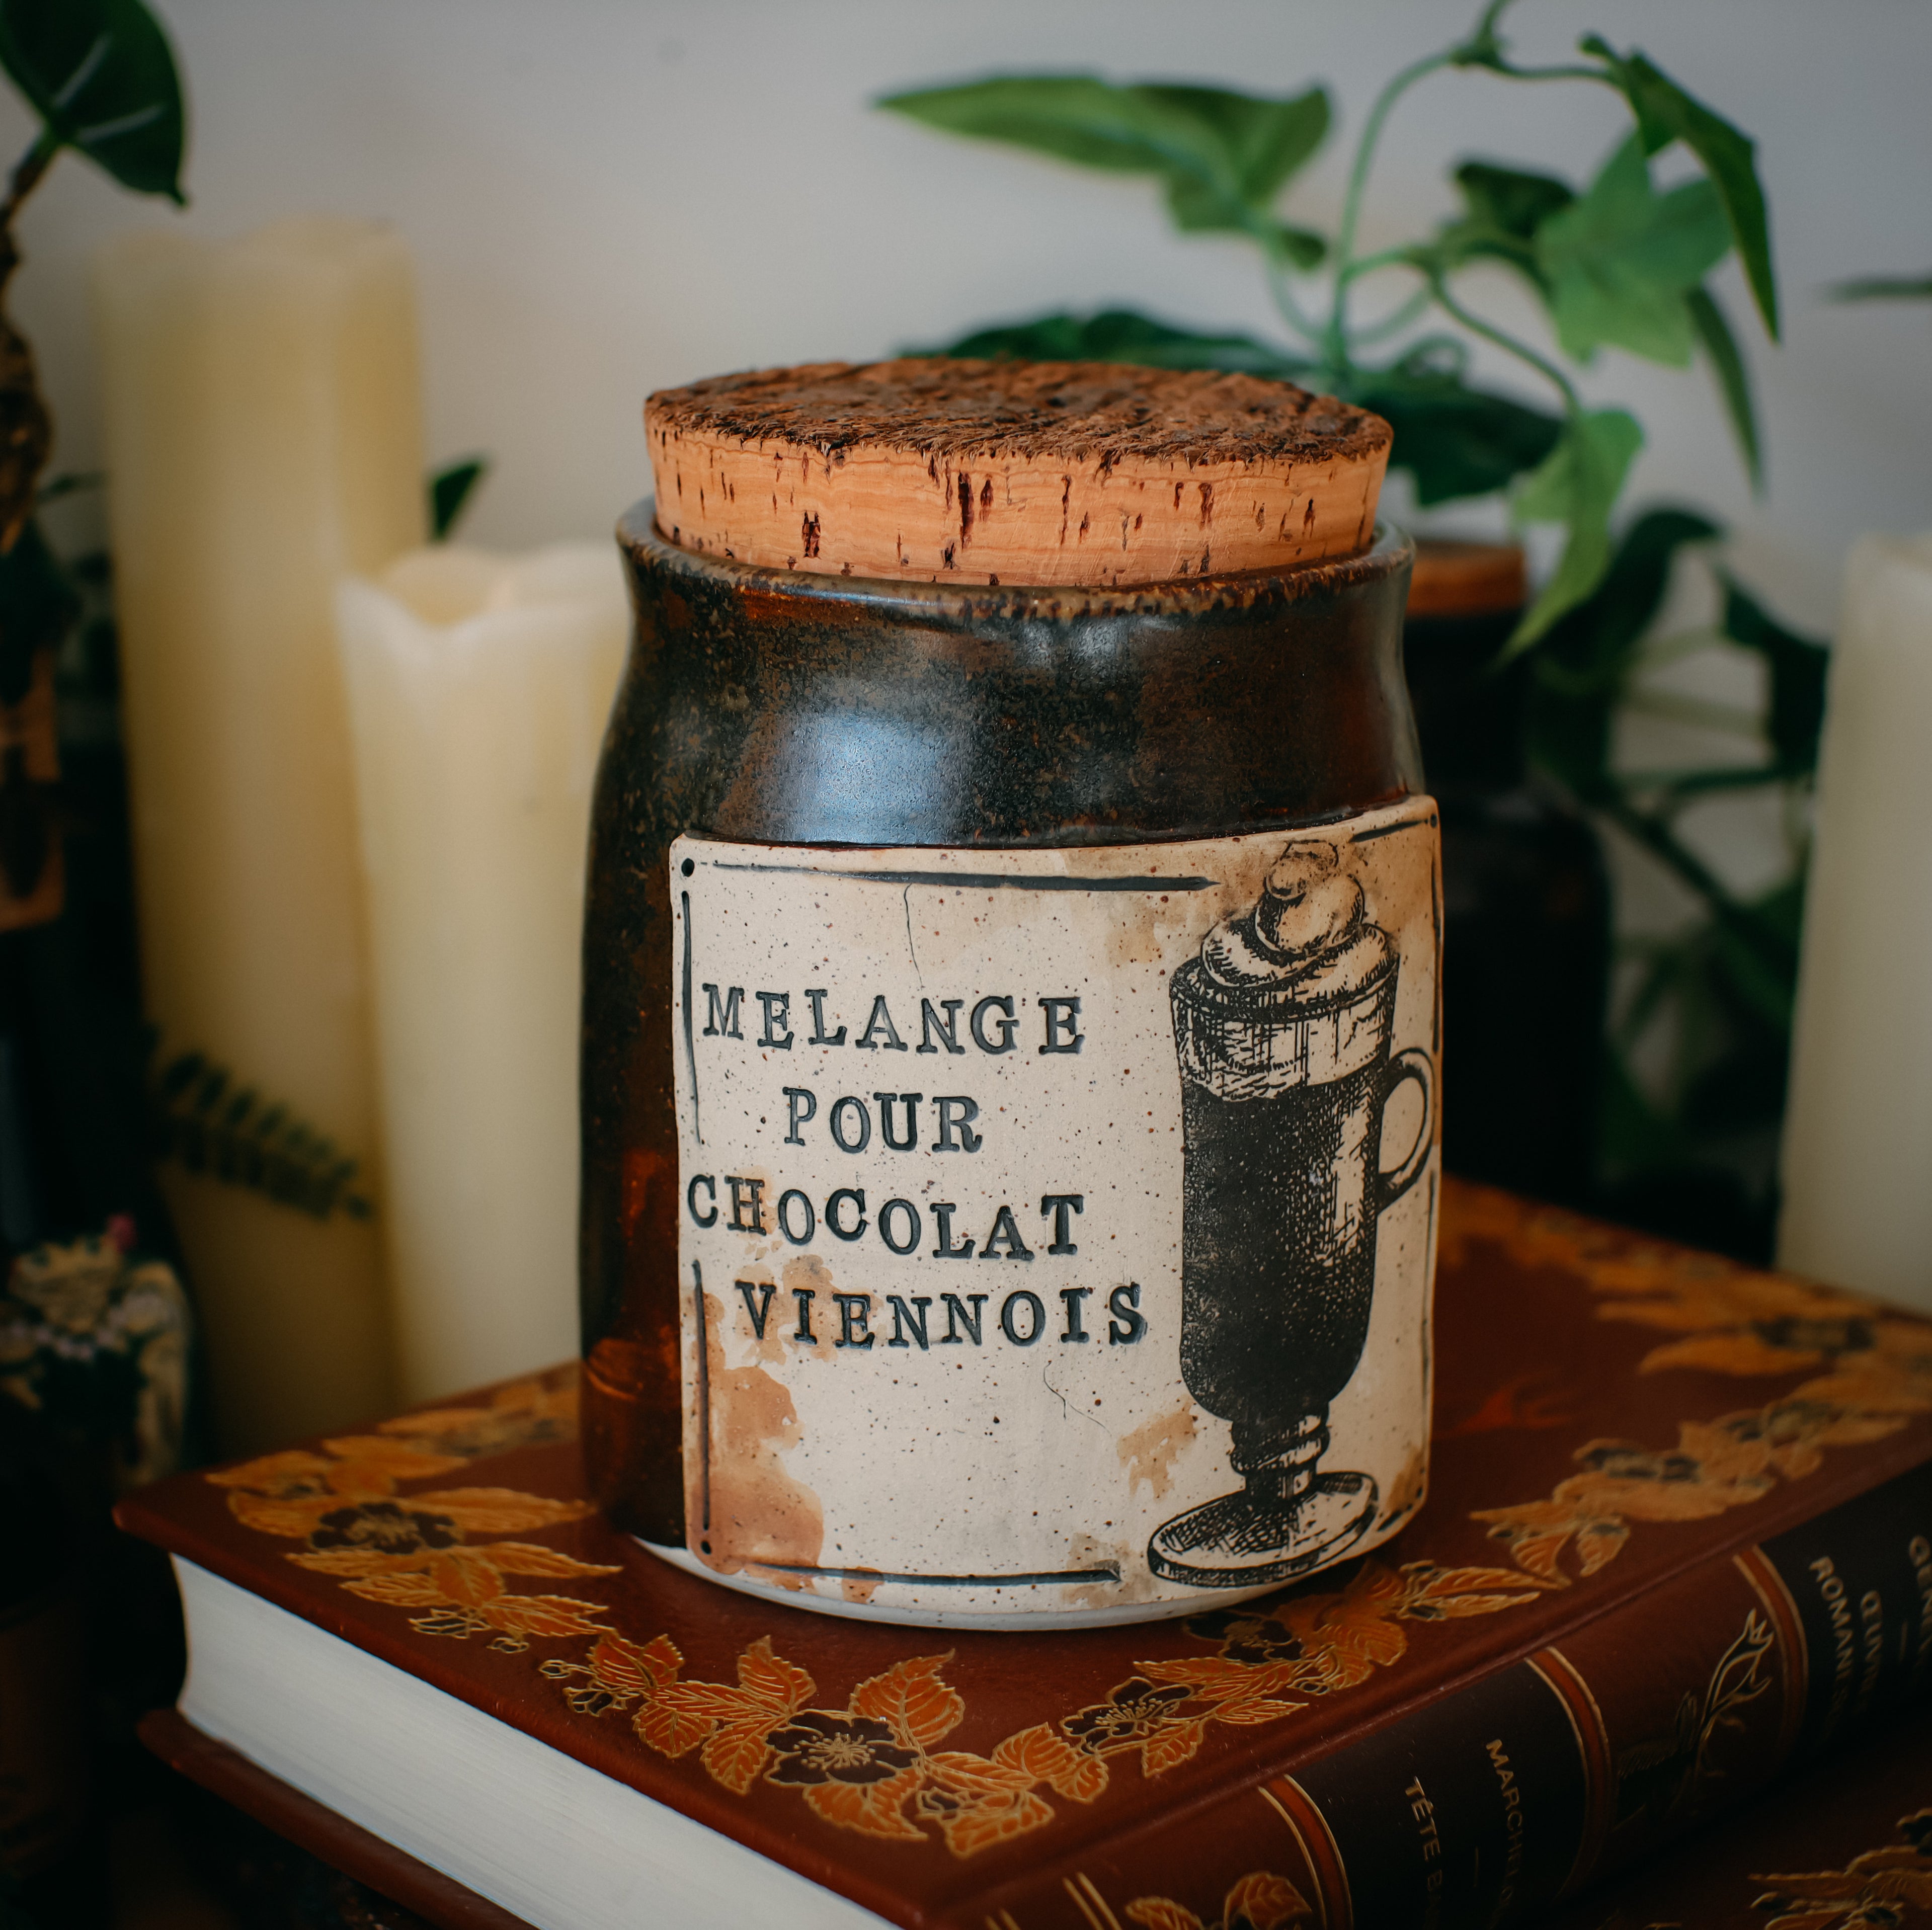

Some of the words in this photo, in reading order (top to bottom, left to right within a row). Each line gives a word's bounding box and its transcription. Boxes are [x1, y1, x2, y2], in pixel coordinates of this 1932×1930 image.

[702, 983, 1085, 1056] MELANGE
[782, 1086, 983, 1153] POUR
[687, 1173, 1084, 1262] CHOCOLAT
[735, 1279, 1148, 1350] VIENNOIS
[1405, 1776, 1440, 1862] TÊTE
